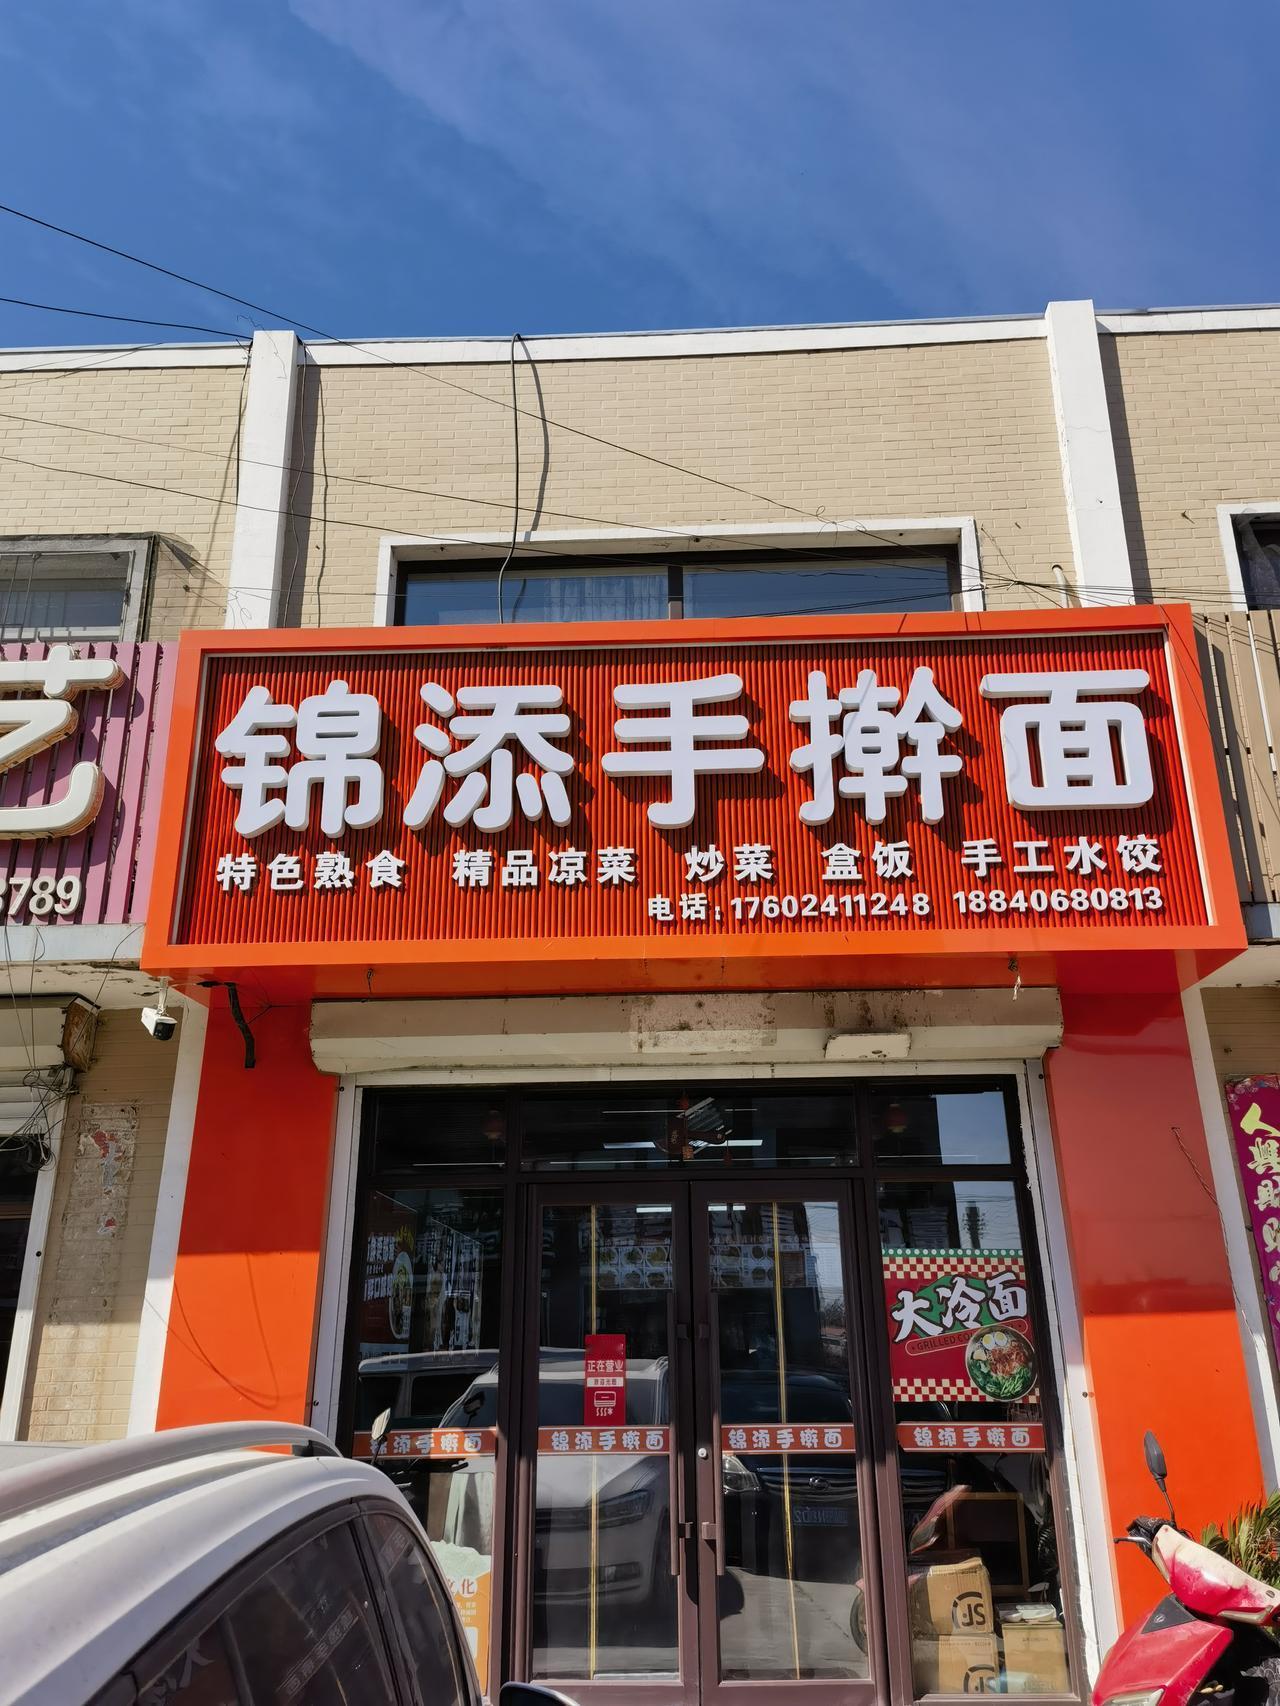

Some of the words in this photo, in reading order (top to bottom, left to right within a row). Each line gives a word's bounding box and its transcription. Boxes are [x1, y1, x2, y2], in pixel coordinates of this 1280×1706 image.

[215, 666, 1153, 838] 锦添手擀面
[216, 850, 405, 890] 特色熟食
[452, 846, 635, 887] 精品凉菜
[685, 843, 773, 882] 炒菜
[821, 841, 914, 880] 盒饭
[961, 834, 1162, 878] 手工水饺
[0, 875, 82, 915] 789
[953, 886, 1163, 914] 18840680813
[891, 1272, 1027, 1342] 大冷面
[917, 1336, 955, 1352] GRILLED
[587, 1360, 624, 1373] 正在营业
